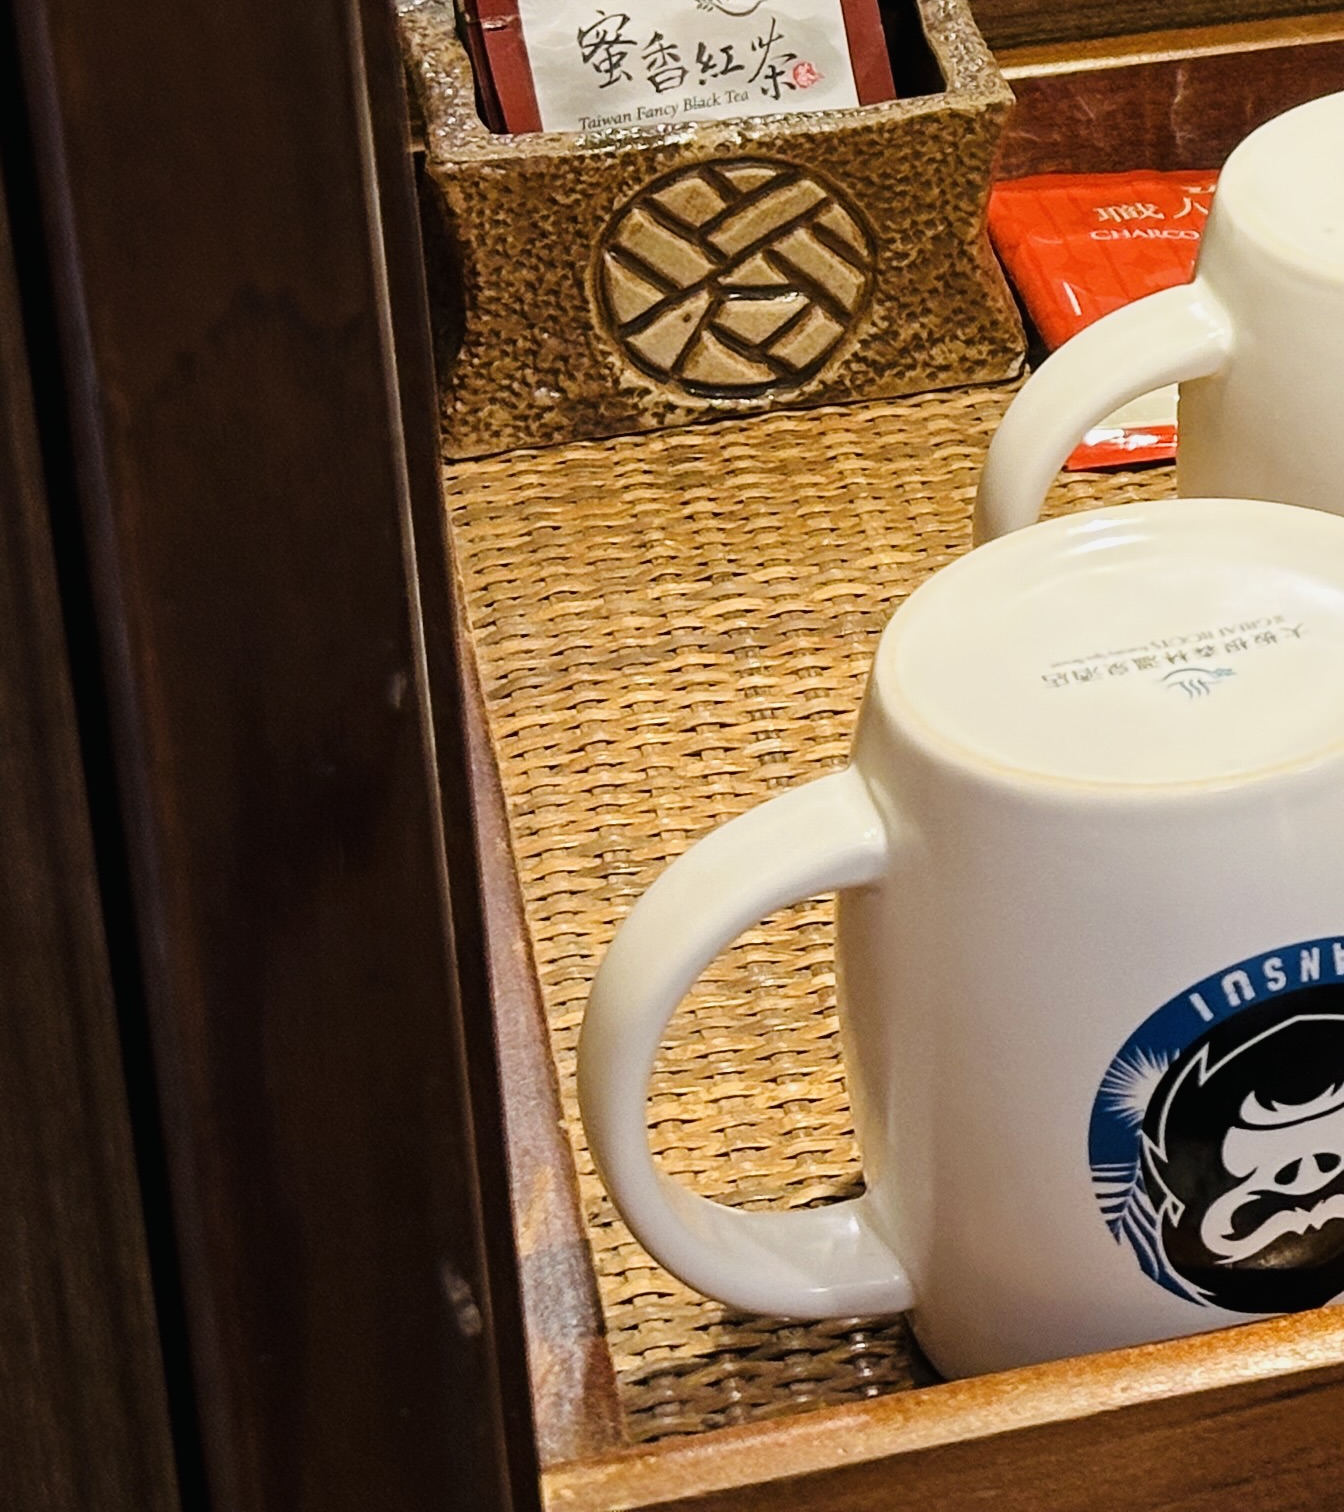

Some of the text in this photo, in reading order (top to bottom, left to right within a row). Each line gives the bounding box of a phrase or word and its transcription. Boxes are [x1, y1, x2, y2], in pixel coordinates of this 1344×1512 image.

[576, 9, 798, 101] 蜜香紅茶
[578, 90, 750, 131] Taiwan Fancy Black Tea
[1089, 228, 1201, 241] CHARCO
